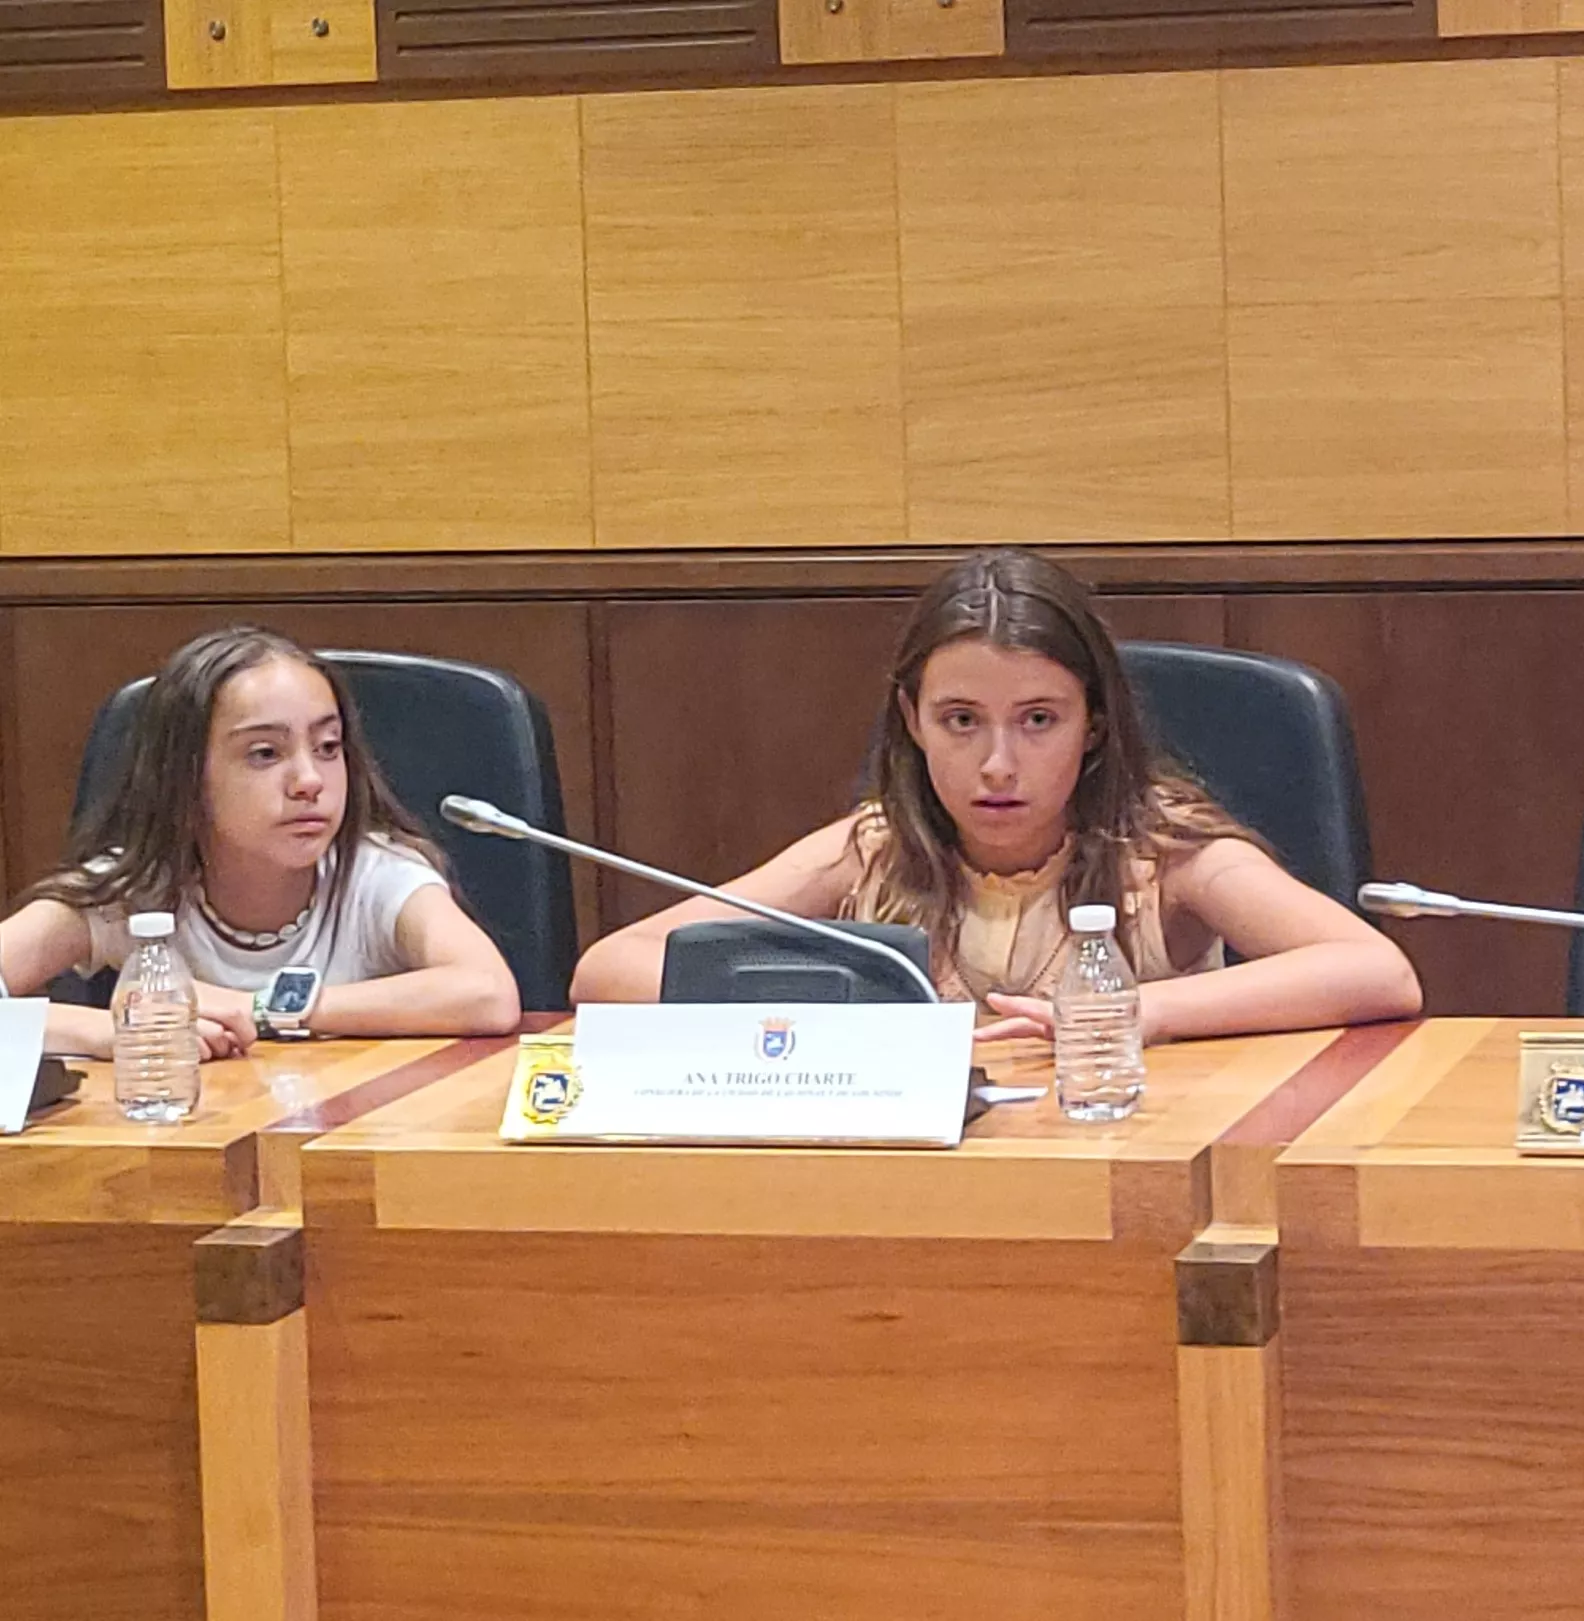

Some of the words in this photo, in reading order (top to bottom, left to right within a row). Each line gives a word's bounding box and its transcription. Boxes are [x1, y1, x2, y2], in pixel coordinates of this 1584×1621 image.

[683, 1072, 718, 1086] ANA
[724, 1072, 780, 1086] TRIGO
[785, 1072, 857, 1086] CHARTE
